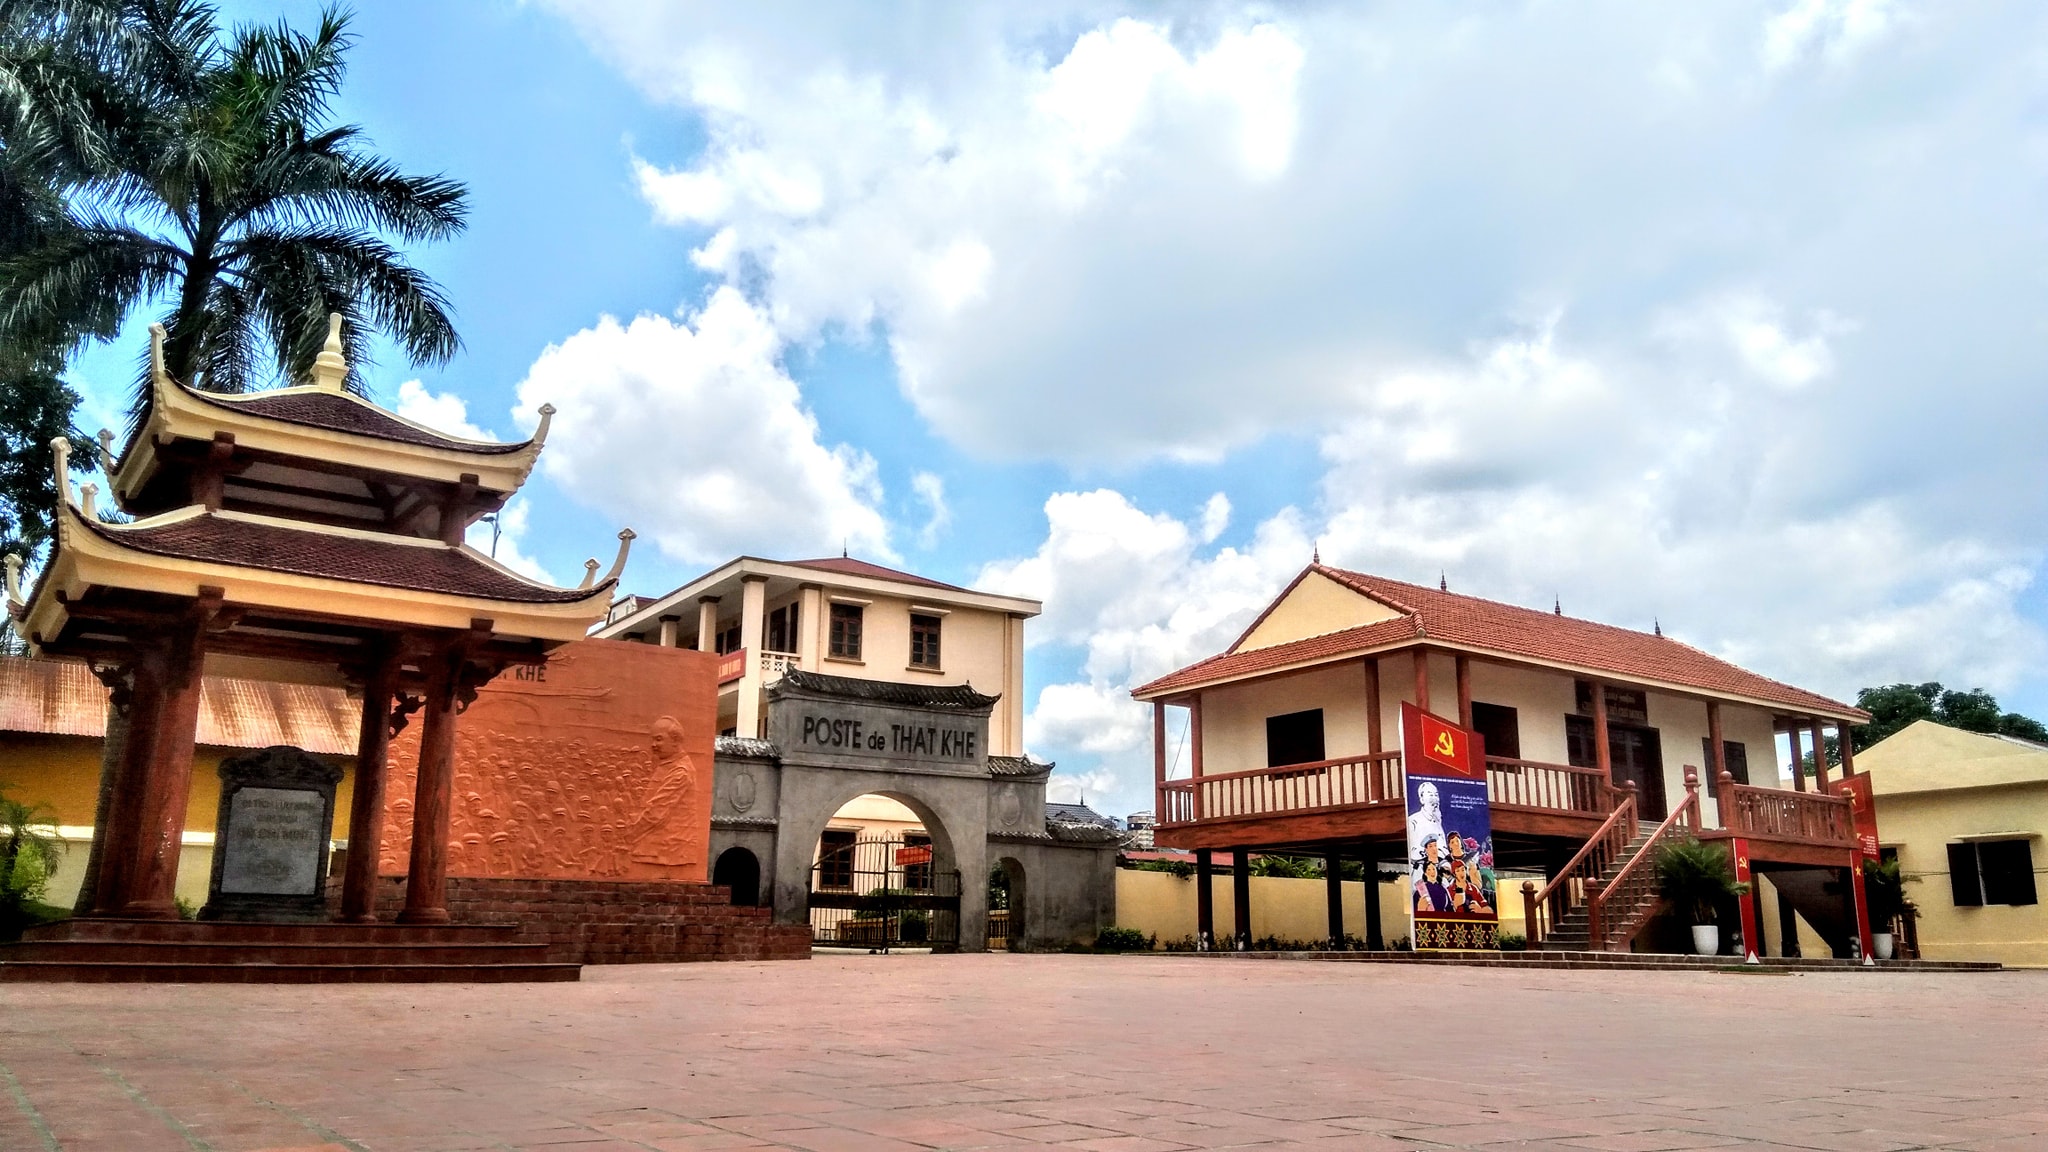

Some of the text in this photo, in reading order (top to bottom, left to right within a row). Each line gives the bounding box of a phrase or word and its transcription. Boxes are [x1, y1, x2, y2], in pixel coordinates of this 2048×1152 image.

[516, 664, 547, 683] KHE
[803, 716, 975, 759] POSTE de THAT KHE
